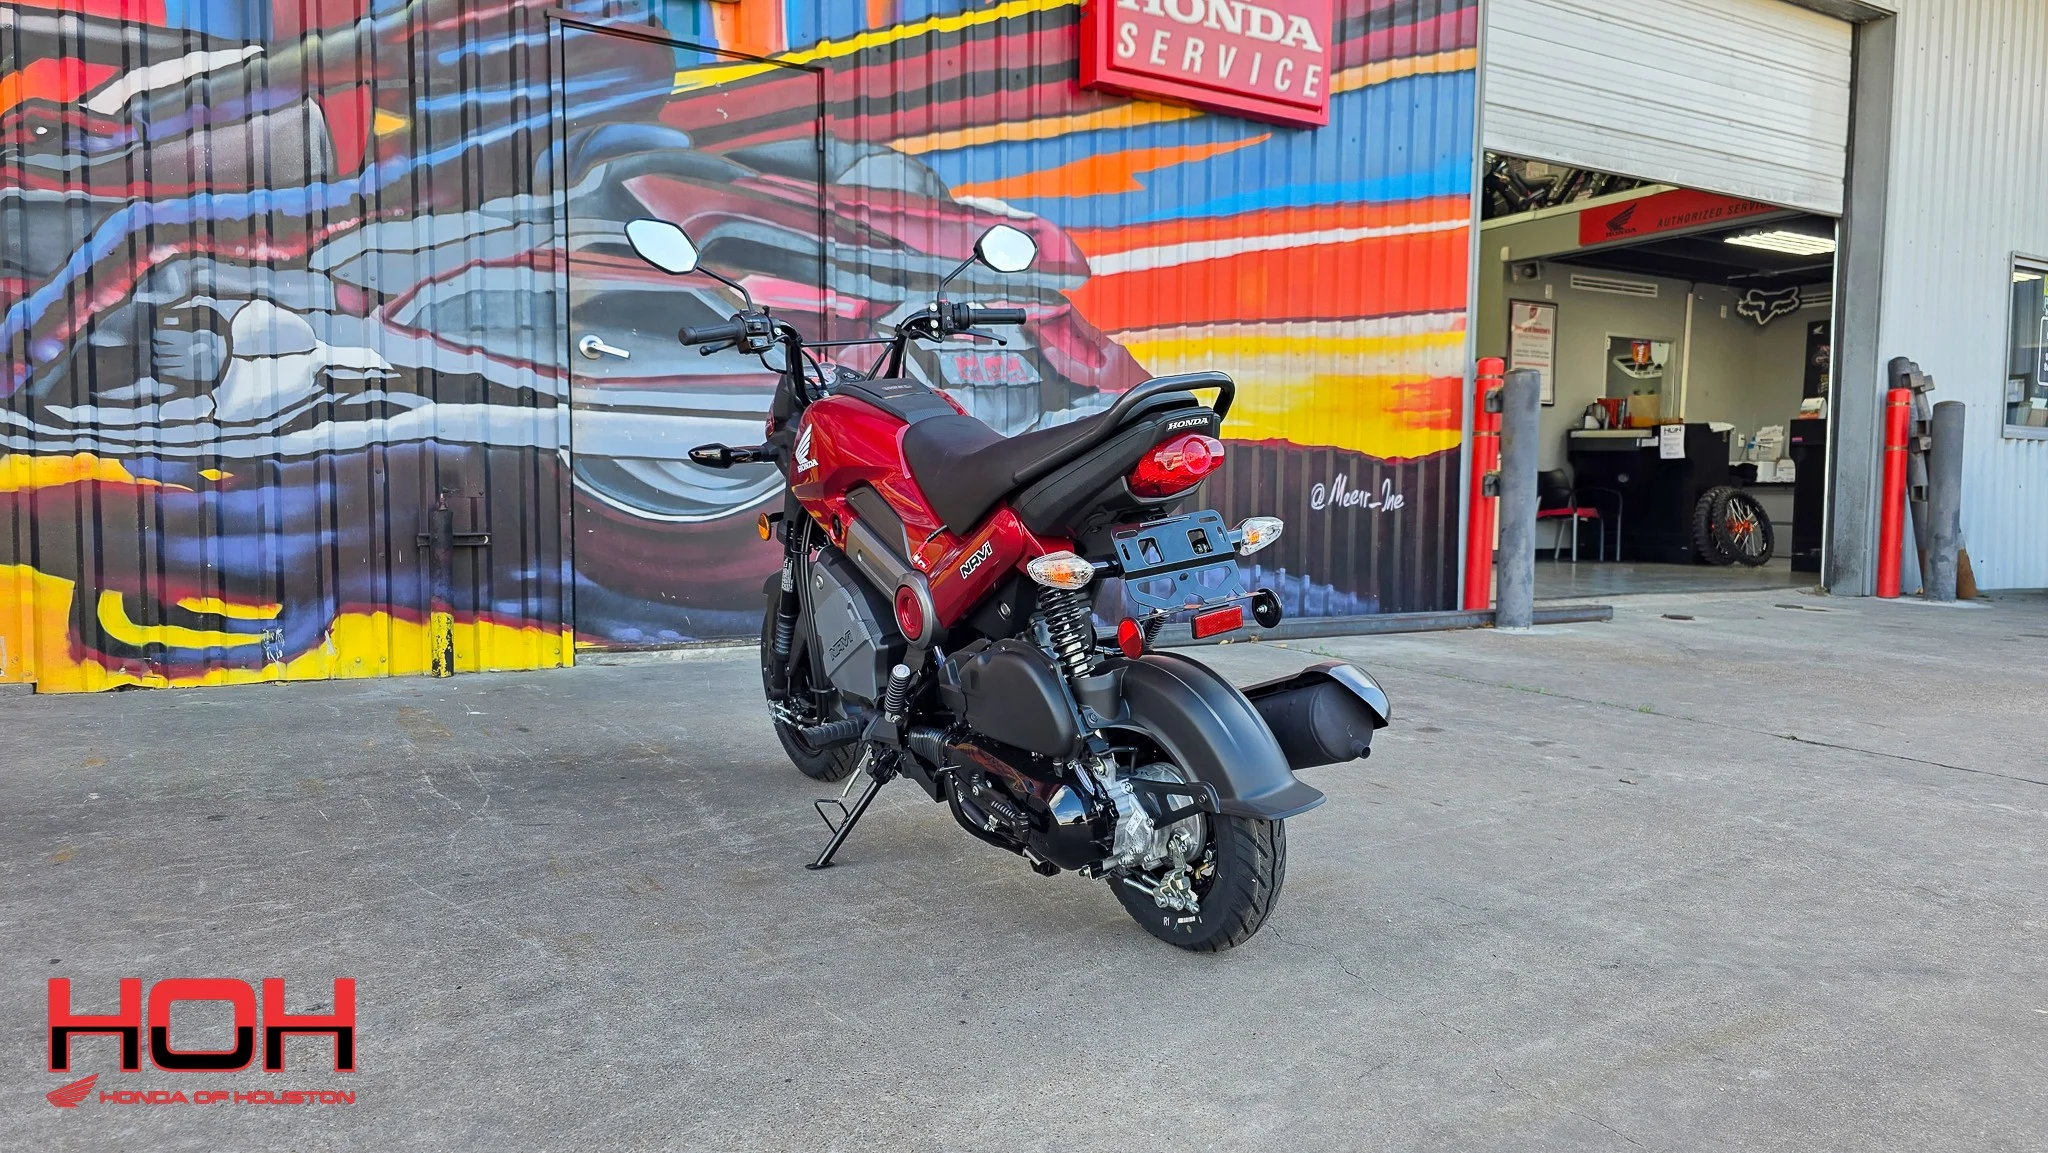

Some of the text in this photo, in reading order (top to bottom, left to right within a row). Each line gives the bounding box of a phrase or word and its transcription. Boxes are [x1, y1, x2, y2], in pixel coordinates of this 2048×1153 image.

[1117, 21, 1322, 97] SERVICE
[1656, 207, 1723, 228] AUTHORIZED
[1167, 417, 1209, 431] HONDA
[797, 459, 819, 474] HONDA
